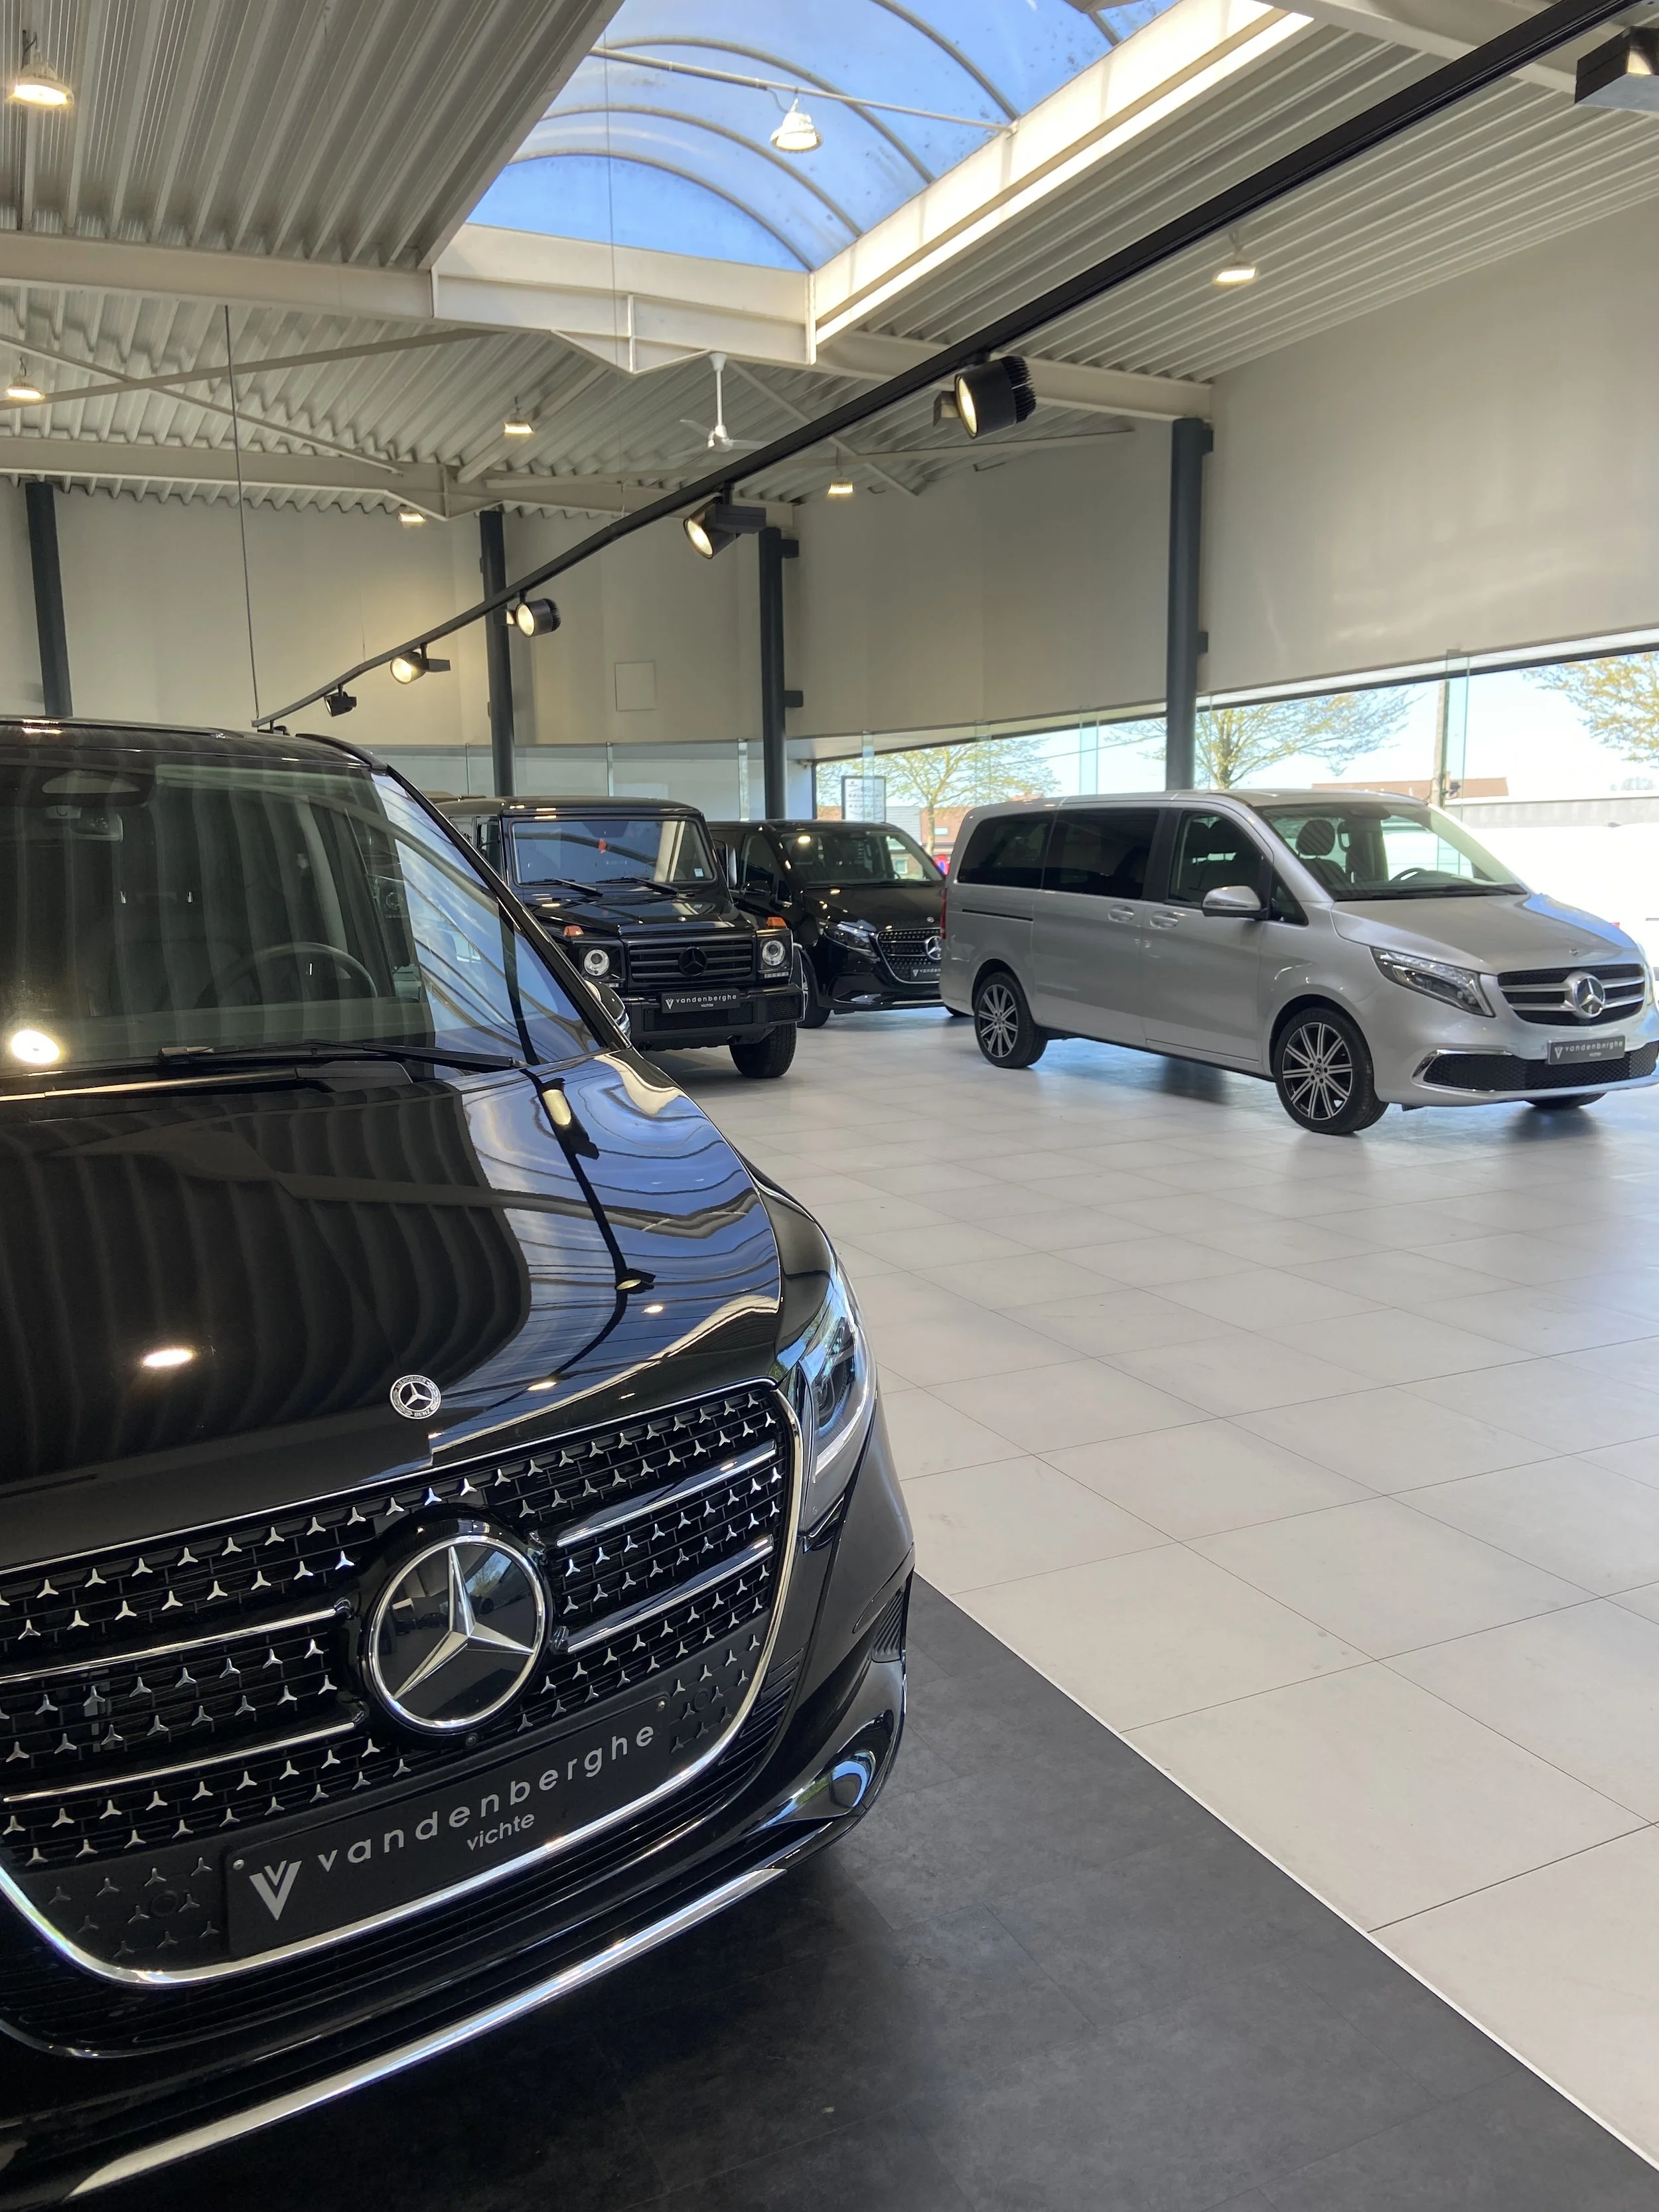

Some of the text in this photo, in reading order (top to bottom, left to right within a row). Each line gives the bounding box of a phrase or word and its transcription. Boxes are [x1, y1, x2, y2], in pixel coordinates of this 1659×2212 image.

[676, 994, 737, 1003] vandenberghe
[1565, 1040, 1623, 1052] vandenberghe
[395, 1376, 427, 1390] MERCEDES
[413, 1408, 432, 1418] BENZ
[318, 1725, 655, 1873] vandenberghe
[467, 1812, 536, 1852] vichte
